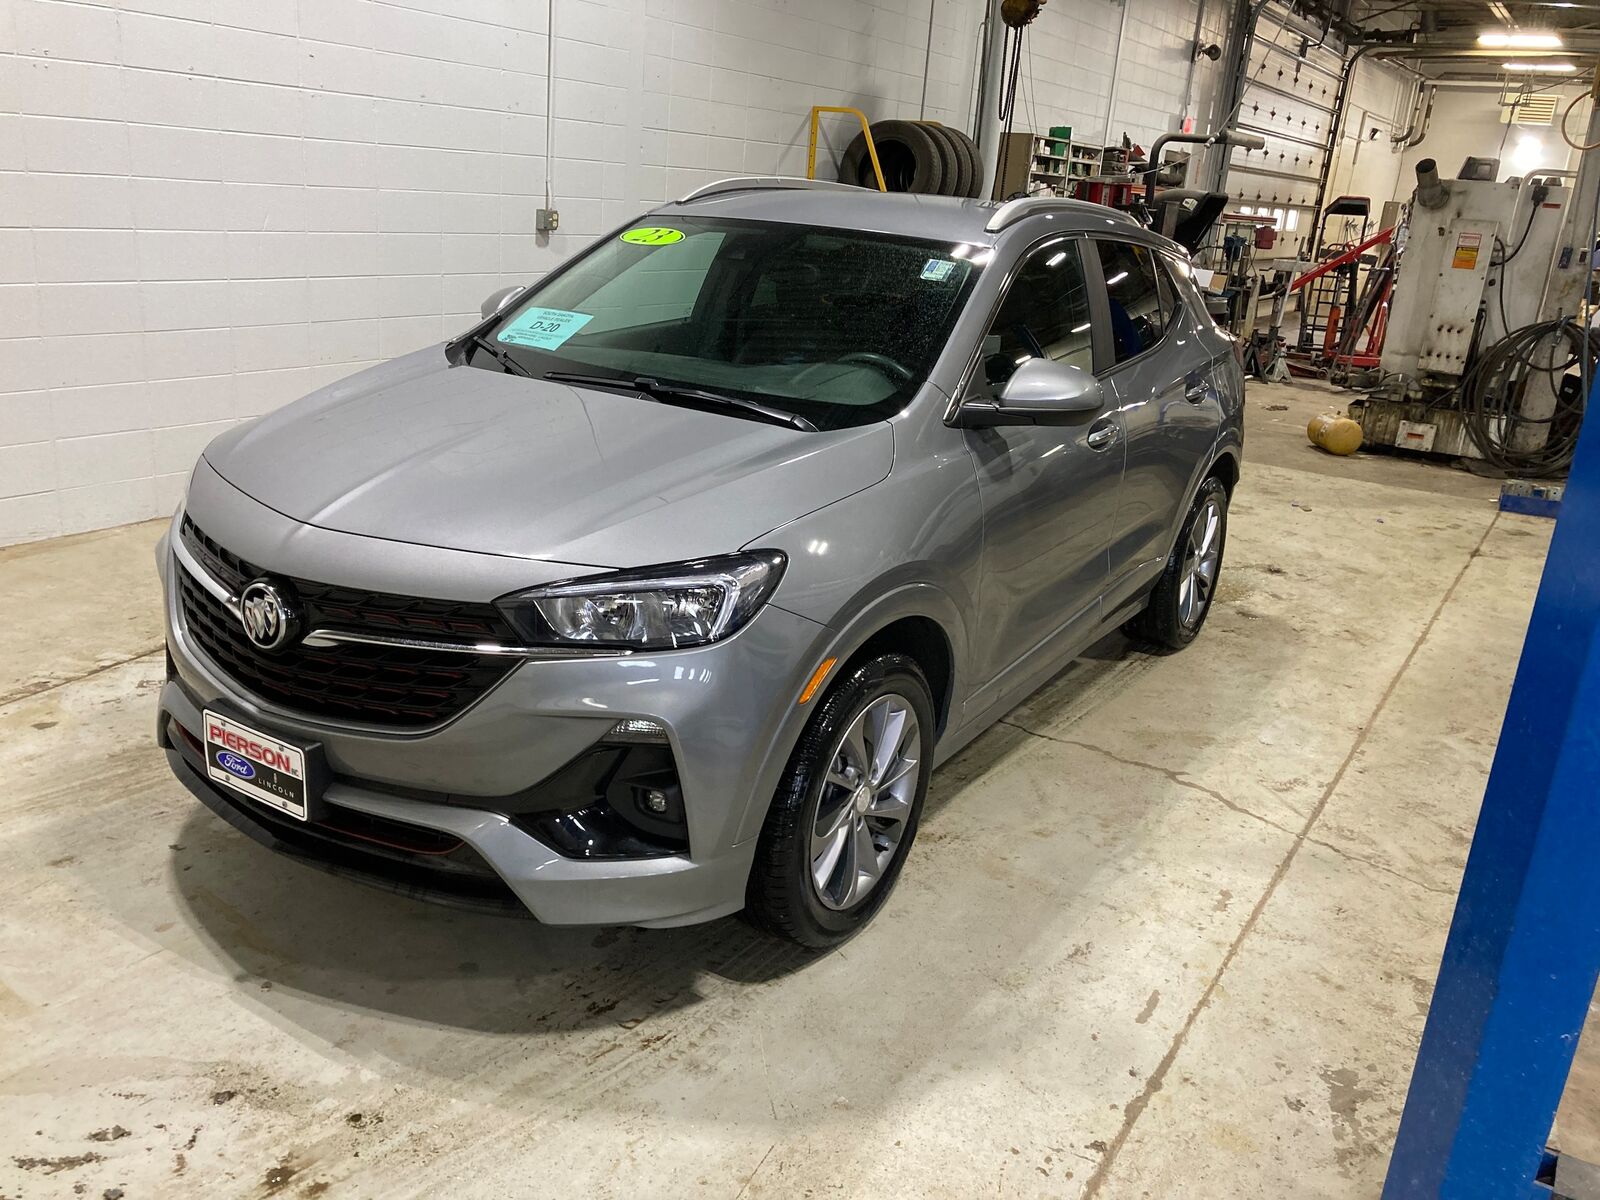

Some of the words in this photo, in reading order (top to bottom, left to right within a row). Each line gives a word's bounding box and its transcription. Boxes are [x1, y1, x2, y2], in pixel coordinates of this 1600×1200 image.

[529, 320, 561, 333] D-20
[208, 723, 291, 773] PIERSON
[223, 753, 248, 775] Ford
[258, 778, 295, 799] LINCOLN
